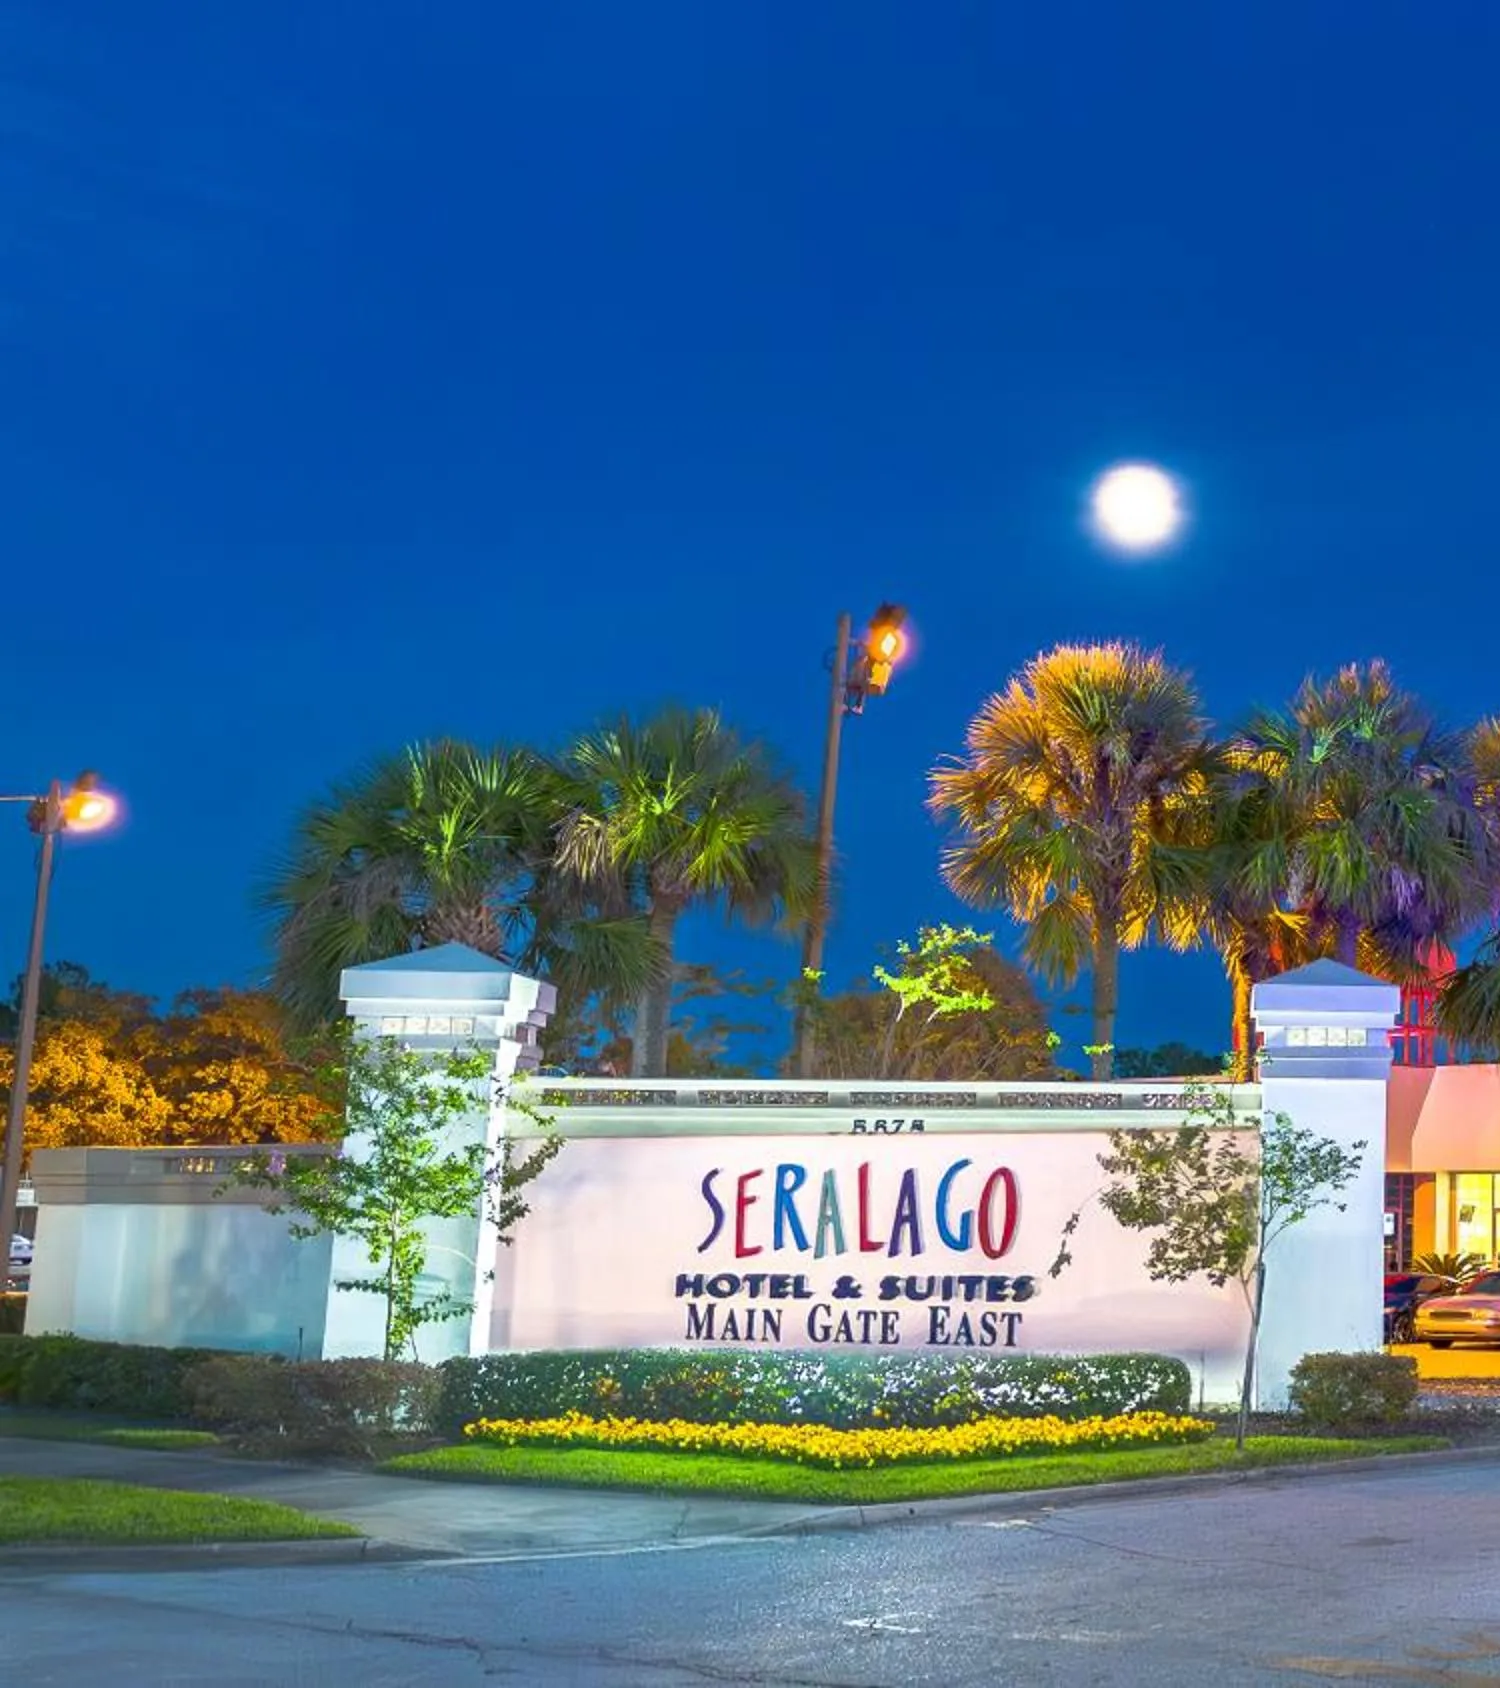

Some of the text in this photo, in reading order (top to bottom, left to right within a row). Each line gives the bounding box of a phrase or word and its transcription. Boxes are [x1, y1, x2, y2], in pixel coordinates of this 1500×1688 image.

[698, 1158, 1022, 1260] SERALAGO
[675, 1273, 1038, 1301] HOTEL & SUITES
[685, 1303, 1023, 1347] MAIN GATE EAST
